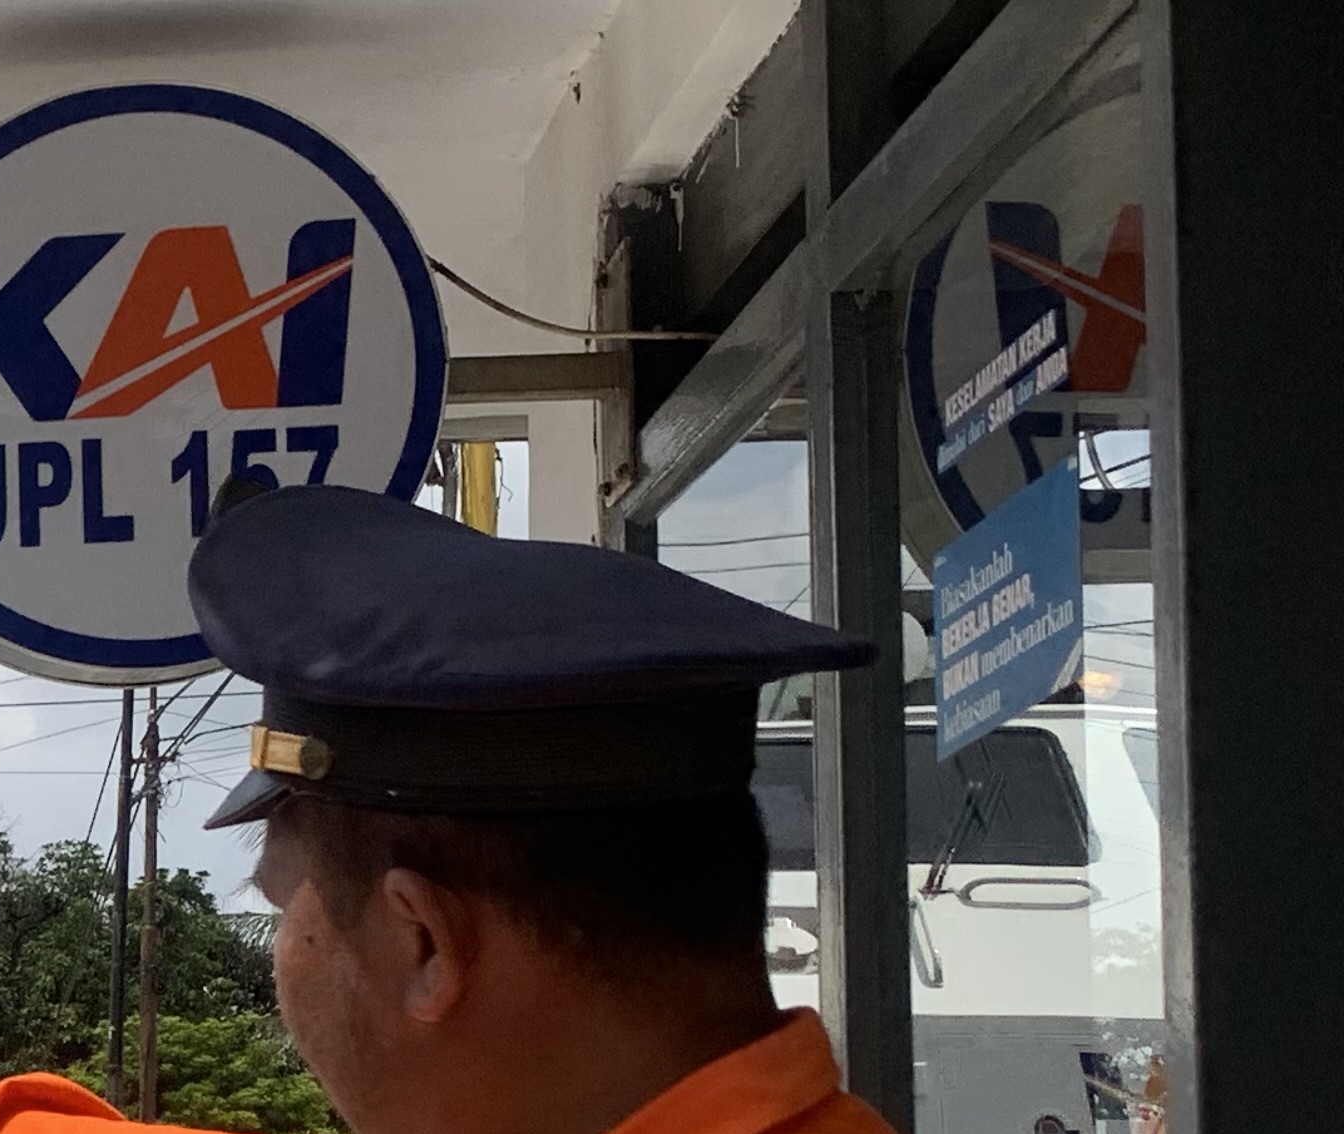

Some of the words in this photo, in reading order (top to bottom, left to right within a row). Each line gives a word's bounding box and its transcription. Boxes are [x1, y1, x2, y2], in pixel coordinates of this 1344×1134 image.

[1019, 308, 1057, 368] KERJA
[988, 388, 1015, 433] SAYA
[1035, 346, 1067, 396] ANDA
[941, 603, 990, 660] BEKERJA
[942, 650, 980, 701] BUKAN
[980, 599, 1075, 675] membenarkan
[943, 688, 1001, 743] kebiasaan
